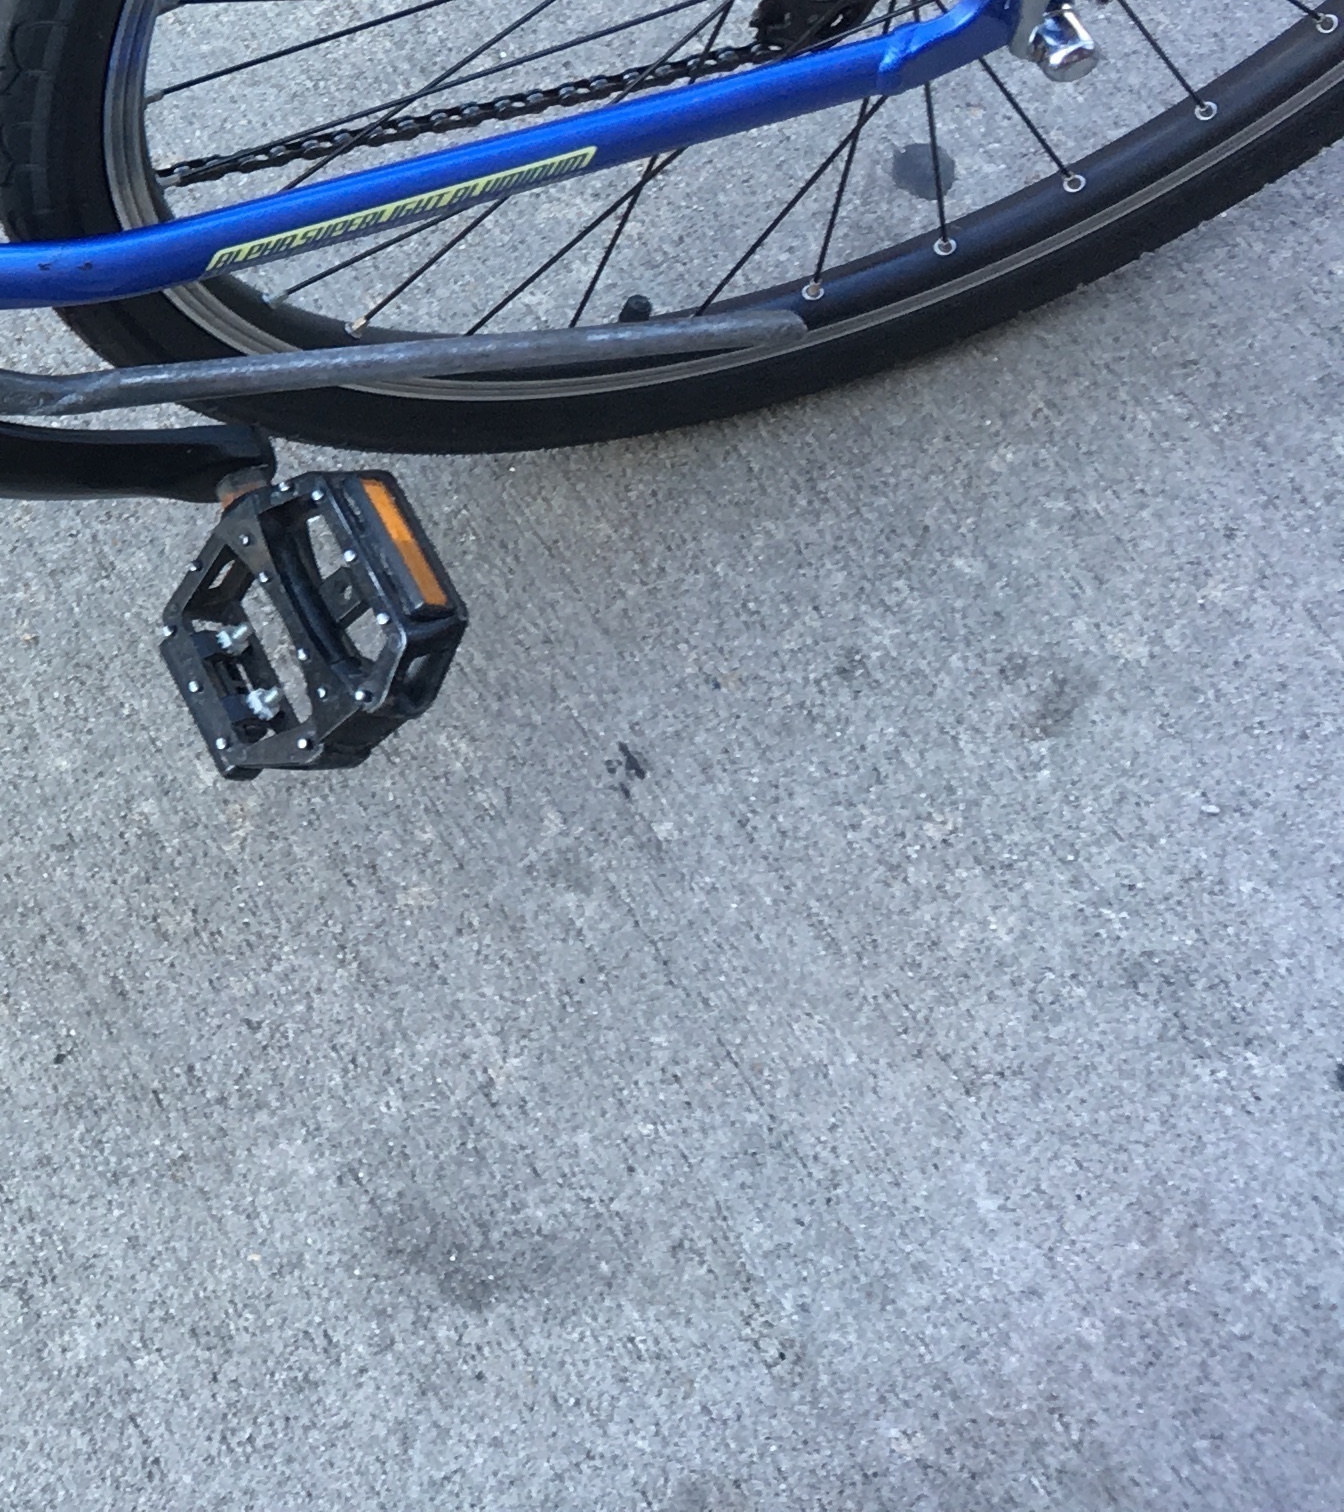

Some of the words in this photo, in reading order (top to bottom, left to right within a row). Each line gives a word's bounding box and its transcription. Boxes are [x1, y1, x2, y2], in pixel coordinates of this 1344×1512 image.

[213, 233, 299, 271] ALPHA
[298, 191, 451, 246] SUPERLIGHT
[451, 152, 589, 207] ALUMINUM
